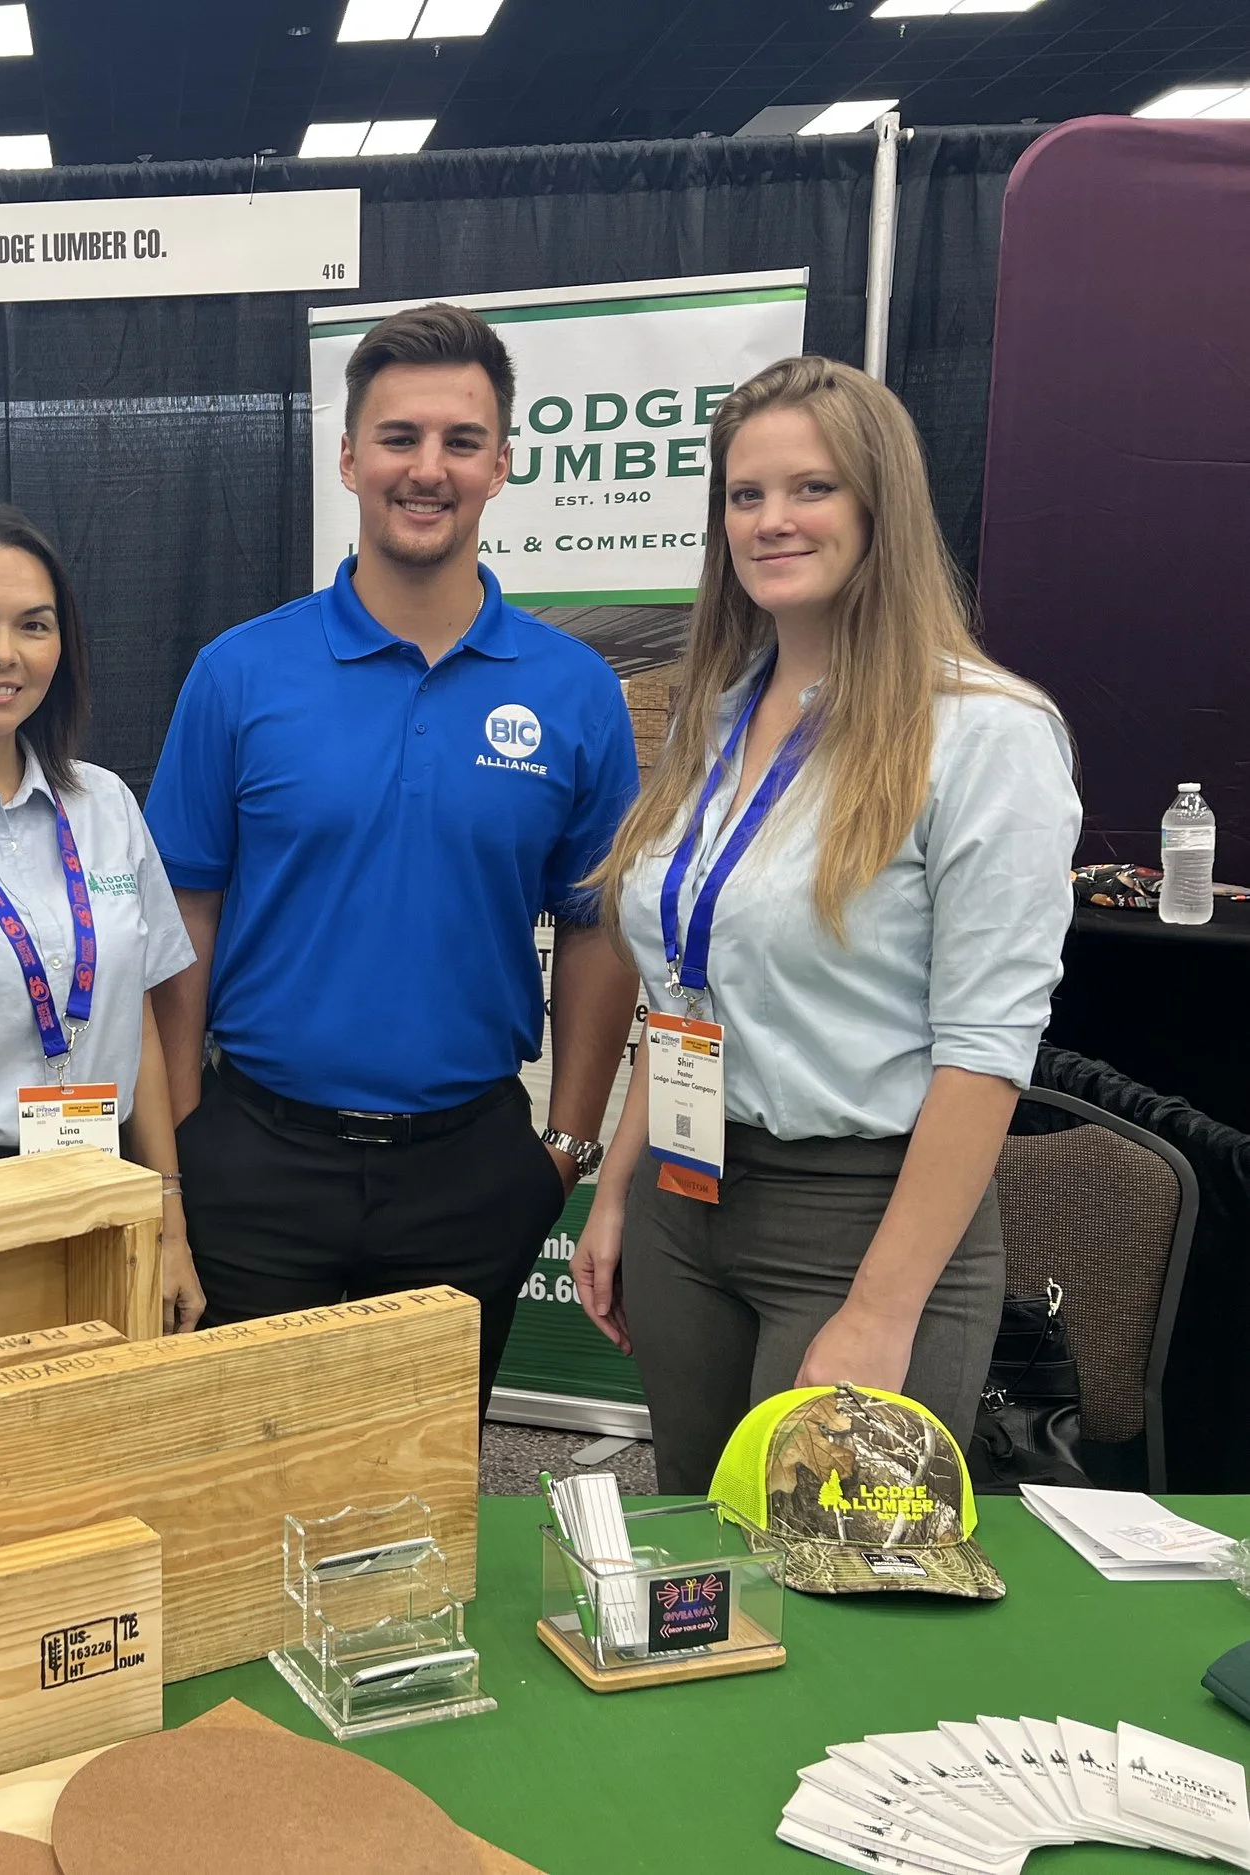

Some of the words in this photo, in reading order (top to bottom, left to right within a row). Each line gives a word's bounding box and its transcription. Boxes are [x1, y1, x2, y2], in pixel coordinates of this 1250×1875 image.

[41, 231, 127, 262] LUMBER
[133, 229, 167, 259] CO.
[322, 264, 345, 280] 416
[507, 382, 735, 437] ODGE
[555, 494, 594, 508] EST.
[603, 491, 651, 505] 1940
[523, 536, 543, 553] &
[491, 717, 538, 746] BIC
[475, 753, 548, 776] ALLIANCE
[99, 873, 135, 884] LODGE
[653, 1074, 669, 1083] Lodge
[671, 1077, 690, 1087] Lumber
[691, 1083, 717, 1096] Company
[59, 1126, 80, 1135] Lina
[271, 1299, 402, 1332] SCAFFOLD
[860, 1484, 927, 1499] LODGE
[852, 1497, 934, 1512] LUMBER
[663, 1605, 716, 1622] GIVEAWAY
[70, 1630, 91, 1645] US-
[668, 1626, 682, 1634] DROP
[683, 1624, 696, 1633] YOUR
[70, 1640, 112, 1661] 163226
[119, 1653, 145, 1668] DUN
[70, 1662, 85, 1678] HT
[1158, 1774, 1237, 1806] LUMBER
[1165, 1770, 1229, 1797] LODGE
